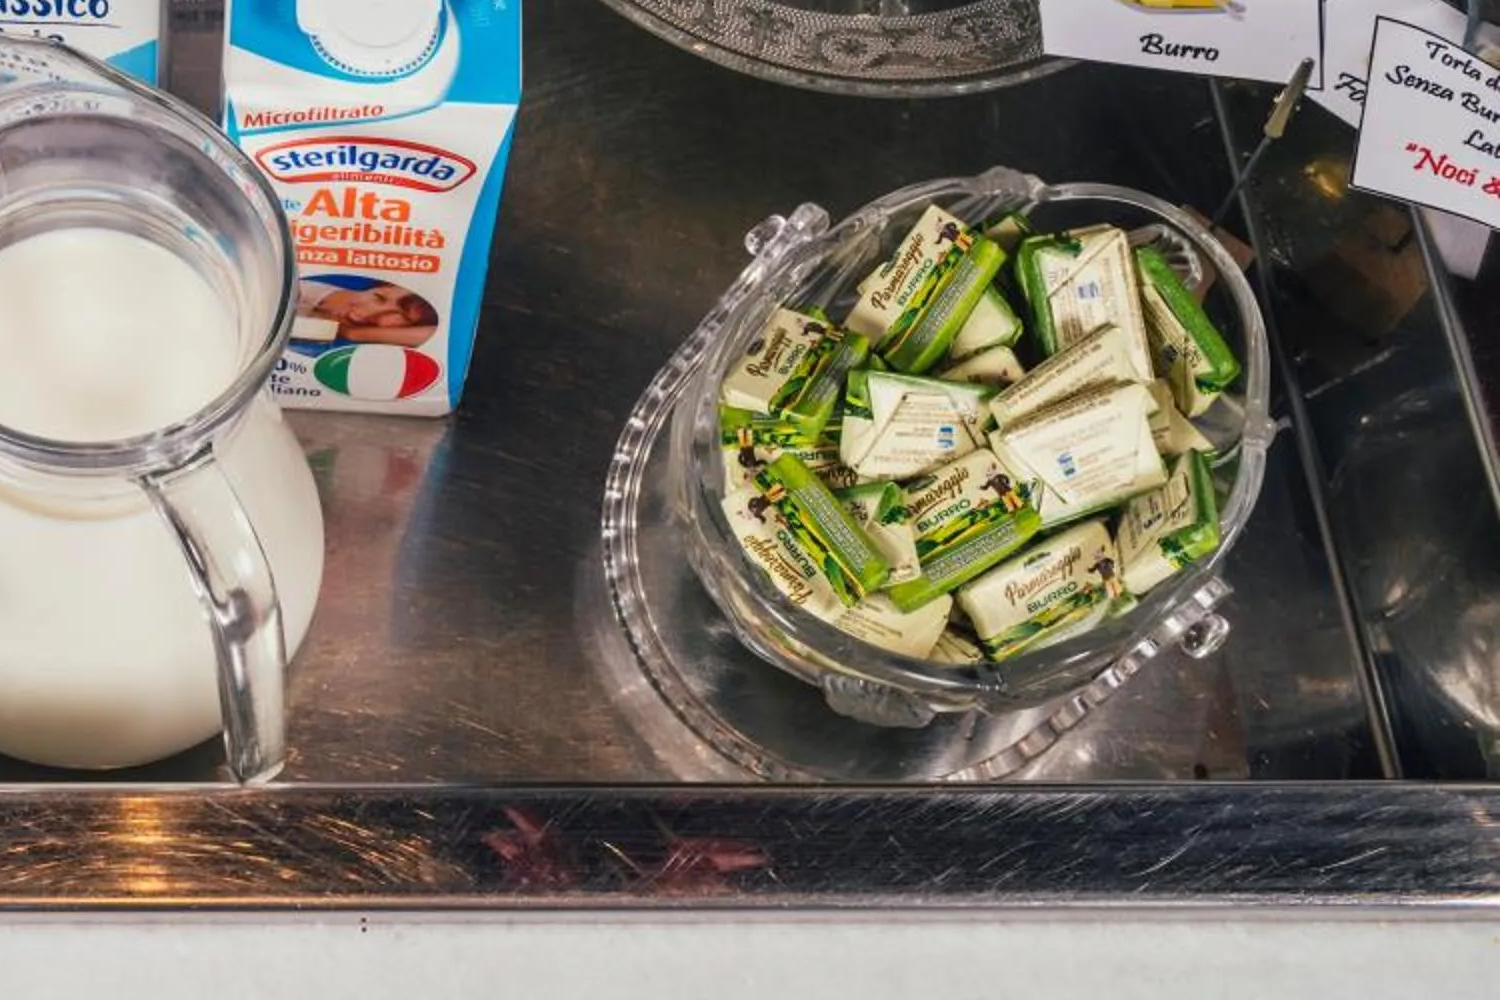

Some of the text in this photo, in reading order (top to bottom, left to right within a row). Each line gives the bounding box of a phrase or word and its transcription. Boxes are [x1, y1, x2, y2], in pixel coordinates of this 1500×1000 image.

[1139, 32, 1220, 63] Burro
[1426, 40, 1481, 83] Torta
[1385, 65, 1454, 102] Senza
[243, 103, 385, 128] Microfiltrato
[272, 146, 456, 181] sterilgarda
[302, 187, 411, 222] Alta
[291, 220, 445, 249] igeribilità
[298, 248, 434, 270] nza lattosio
[896, 257, 934, 307] BURRO
[917, 498, 972, 534] BURRO
[777, 530, 817, 579] BURRO
[1004, 546, 1082, 605] Parmareggio
[1027, 580, 1079, 614] BURRO
